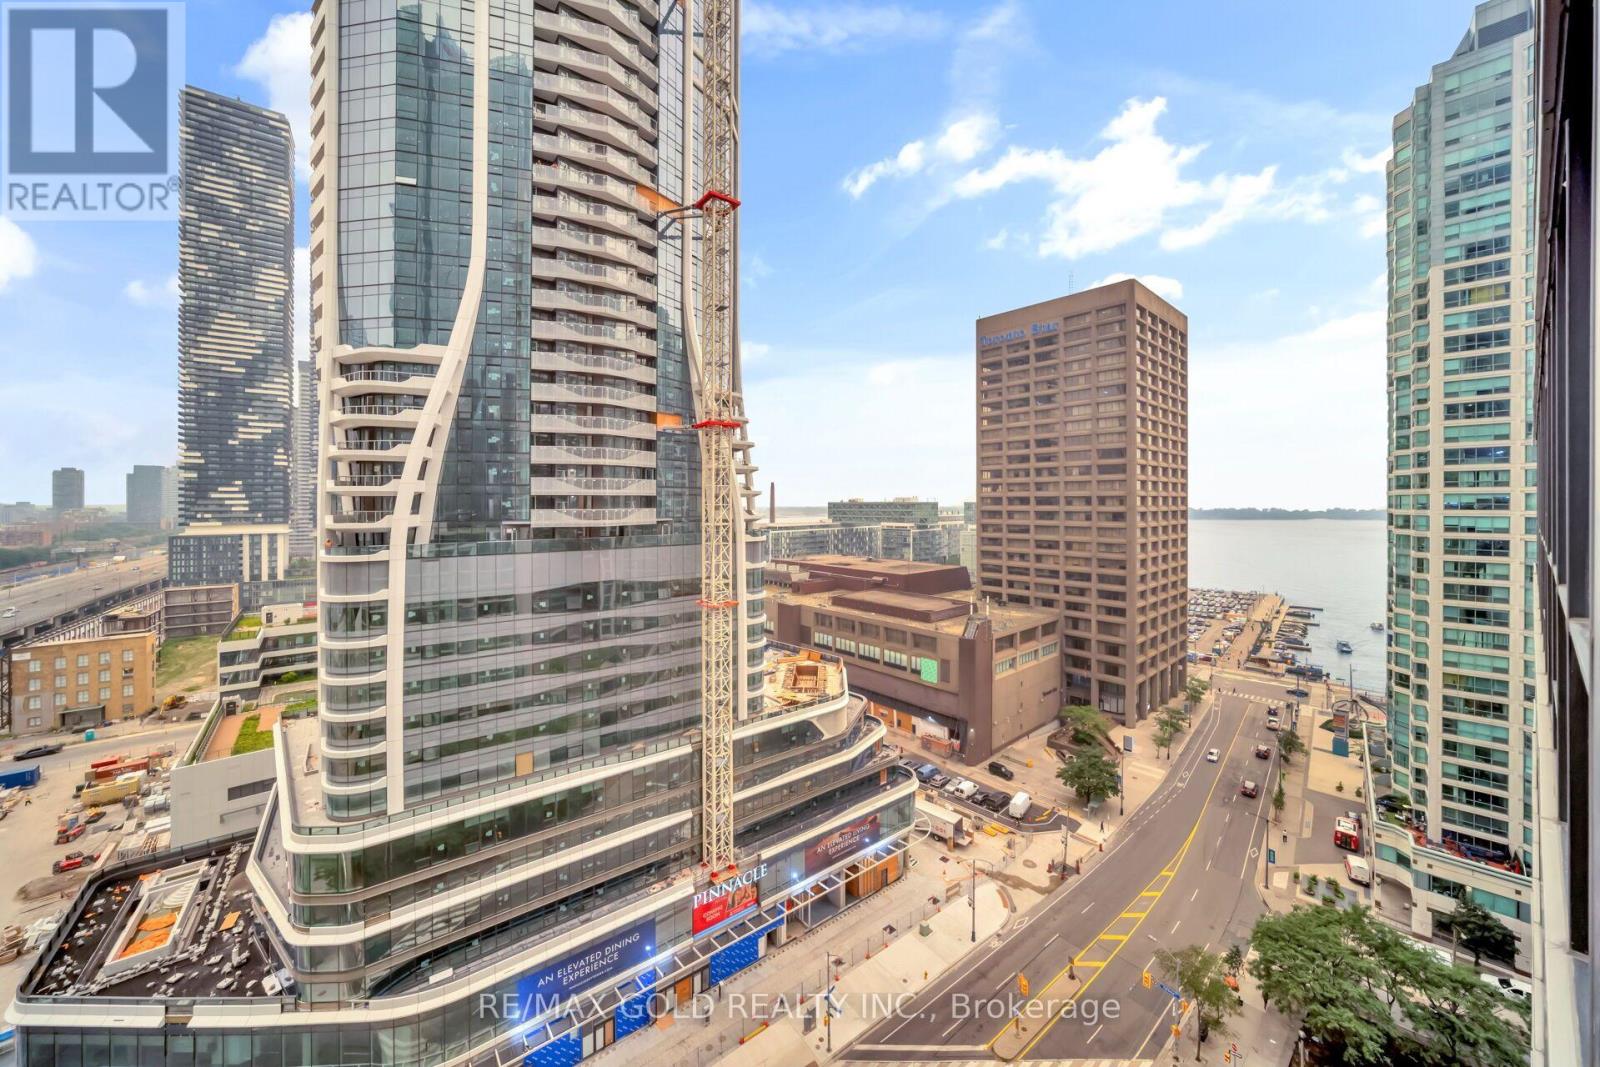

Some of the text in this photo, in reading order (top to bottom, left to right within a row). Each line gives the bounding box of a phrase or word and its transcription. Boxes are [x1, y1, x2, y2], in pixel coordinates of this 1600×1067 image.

[693, 863, 768, 909] PINNACLE
[537, 973, 554, 988] AN
[557, 951, 602, 978] ELEVATED
[604, 932, 640, 956] DINING
[562, 951, 619, 985] EXPERIENCE
